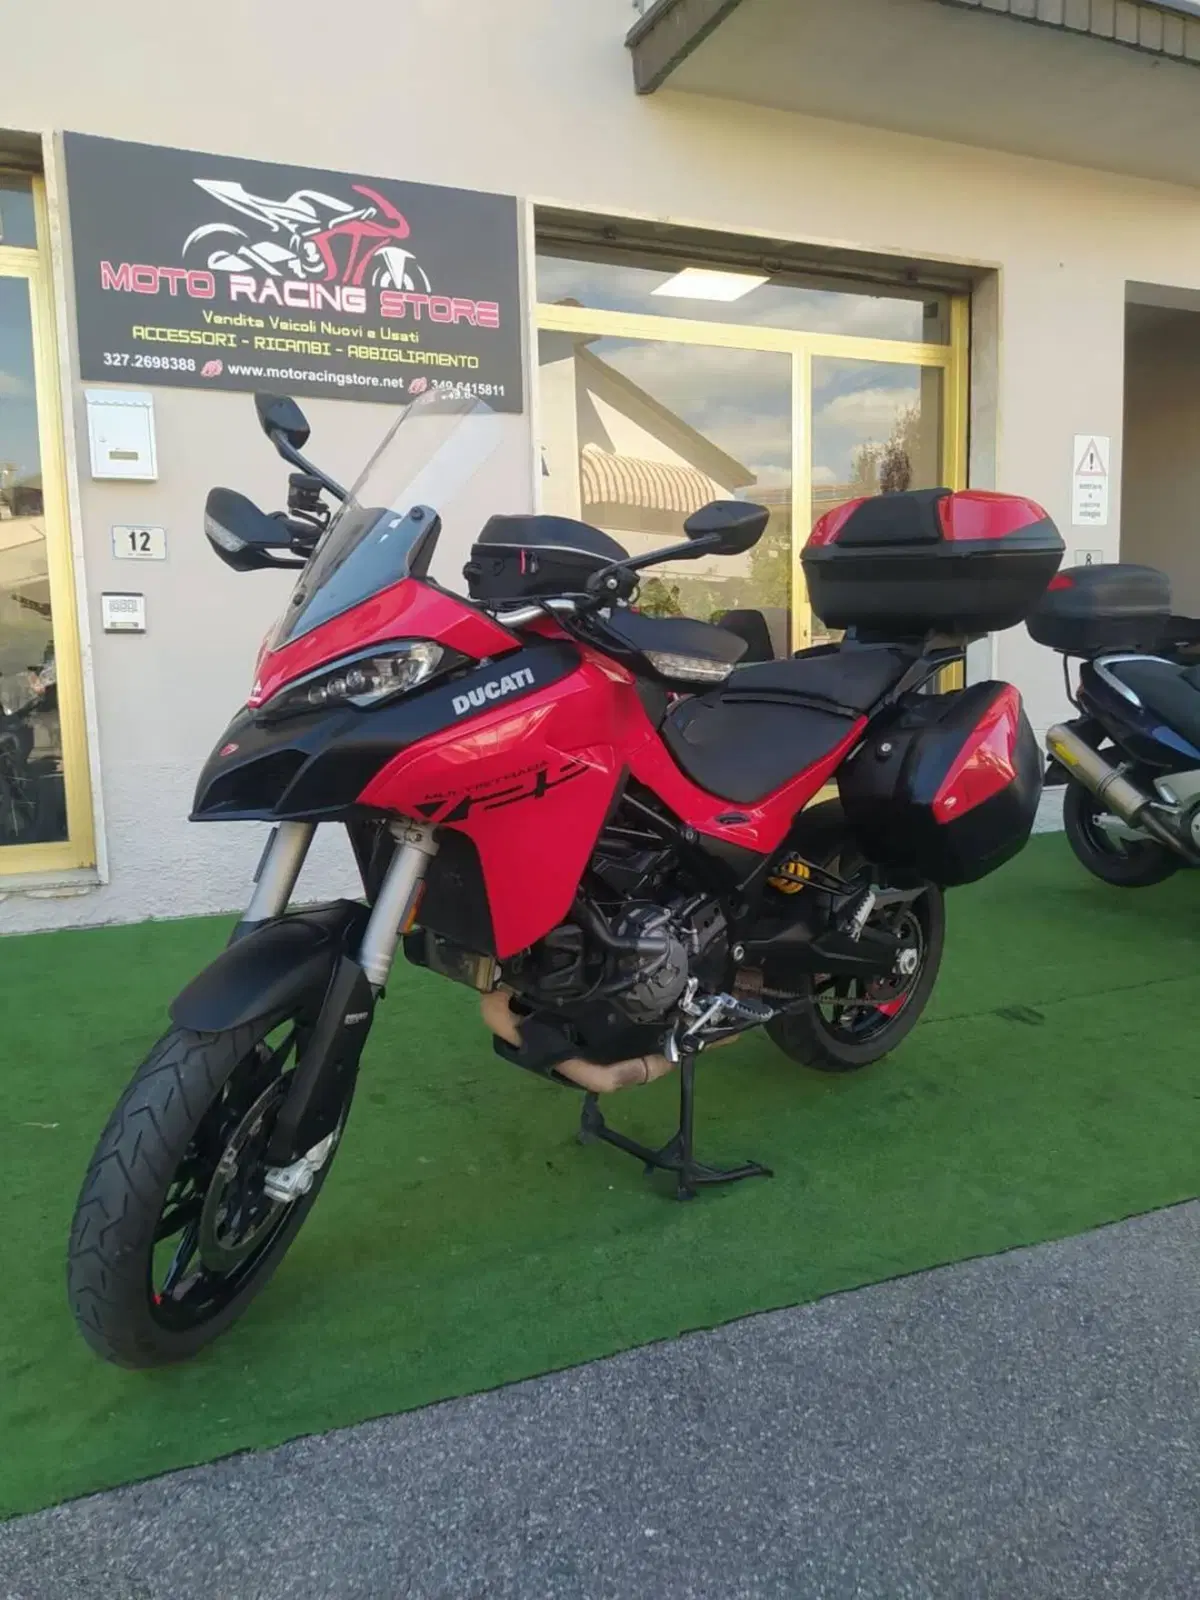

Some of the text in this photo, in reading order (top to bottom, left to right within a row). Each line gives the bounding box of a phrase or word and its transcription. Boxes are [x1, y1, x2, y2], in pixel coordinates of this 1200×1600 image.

[100, 261, 500, 328] MOTO RACING STORE
[202, 309, 420, 343] Vendita Veicoli Nuovi e Usati
[132, 325, 237, 347] ACCESSORI
[254, 336, 332, 356] RICAMBI
[347, 344, 479, 369] ABBIGLIAMENTO
[103, 352, 196, 372] 327.2698388
[227, 363, 404, 388] www.motoracingstore.net
[129, 531, 151, 552] 12
[452, 668, 535, 715] DUCATI
